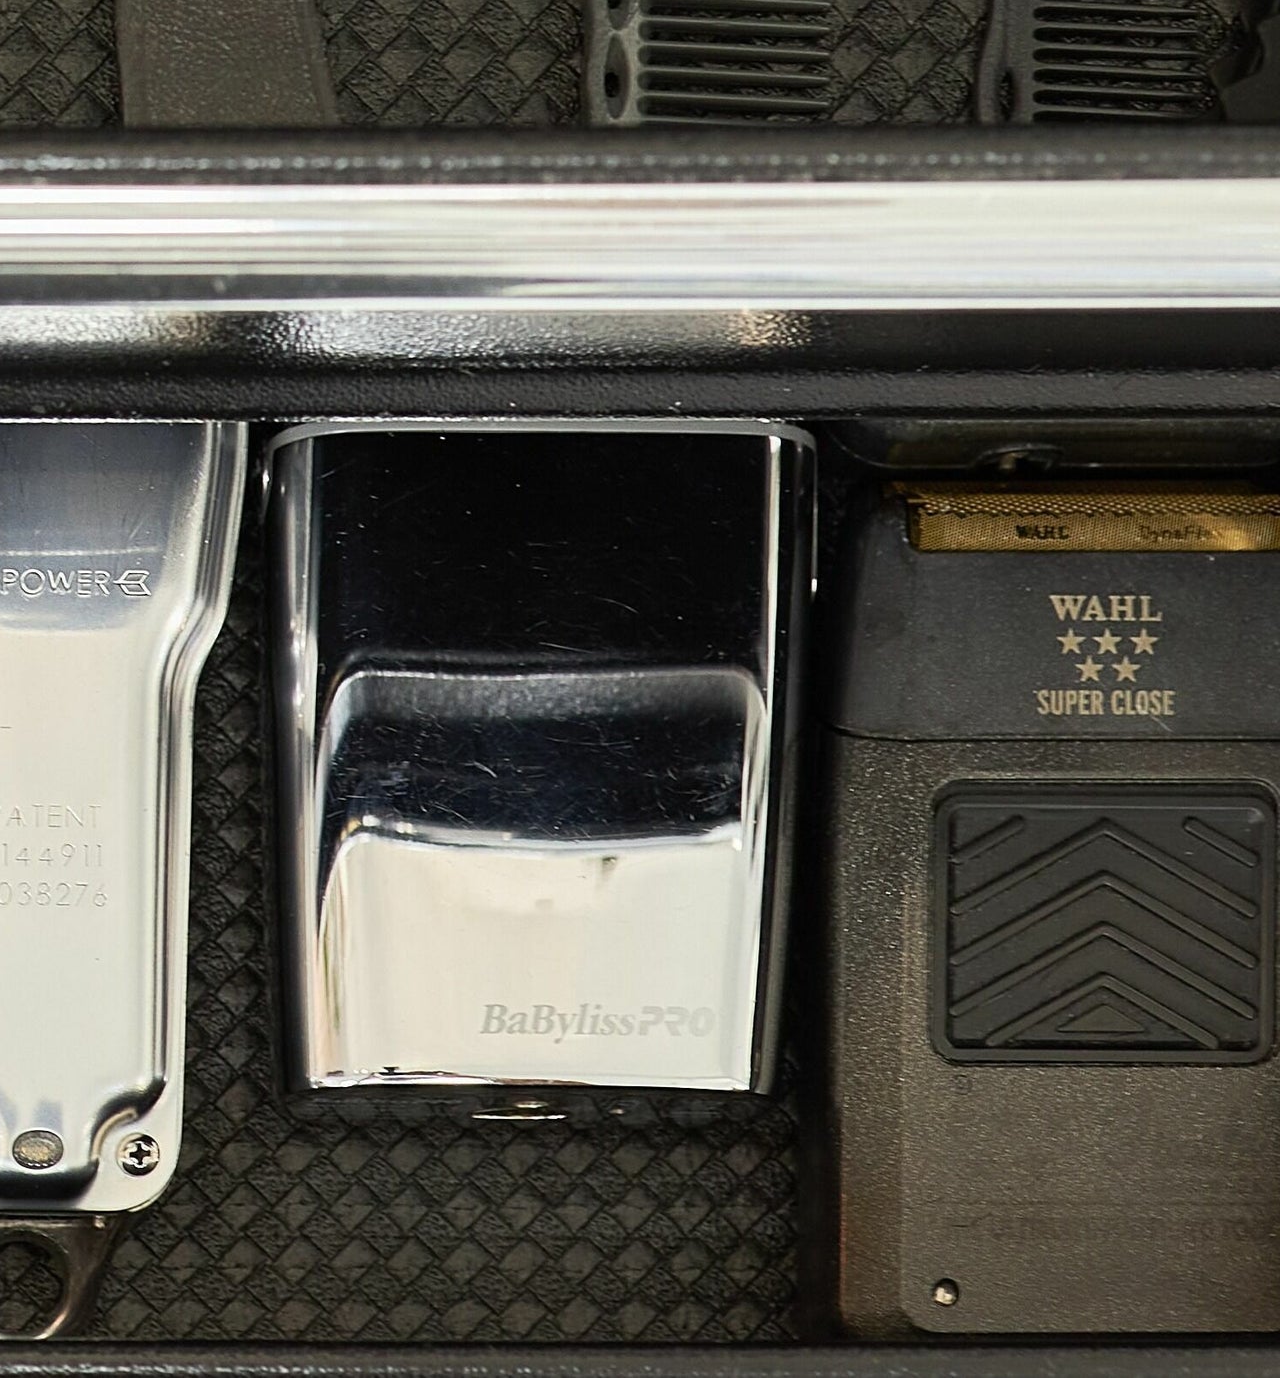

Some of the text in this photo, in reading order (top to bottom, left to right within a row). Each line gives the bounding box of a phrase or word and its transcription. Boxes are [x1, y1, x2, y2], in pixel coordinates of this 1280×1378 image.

[0, 568, 112, 599] POWER
[1049, 595, 1163, 622] WAHL
[1037, 689, 1176, 715] SUPER CLOSE
[480, 1003, 717, 1044] BaBylissPRO
